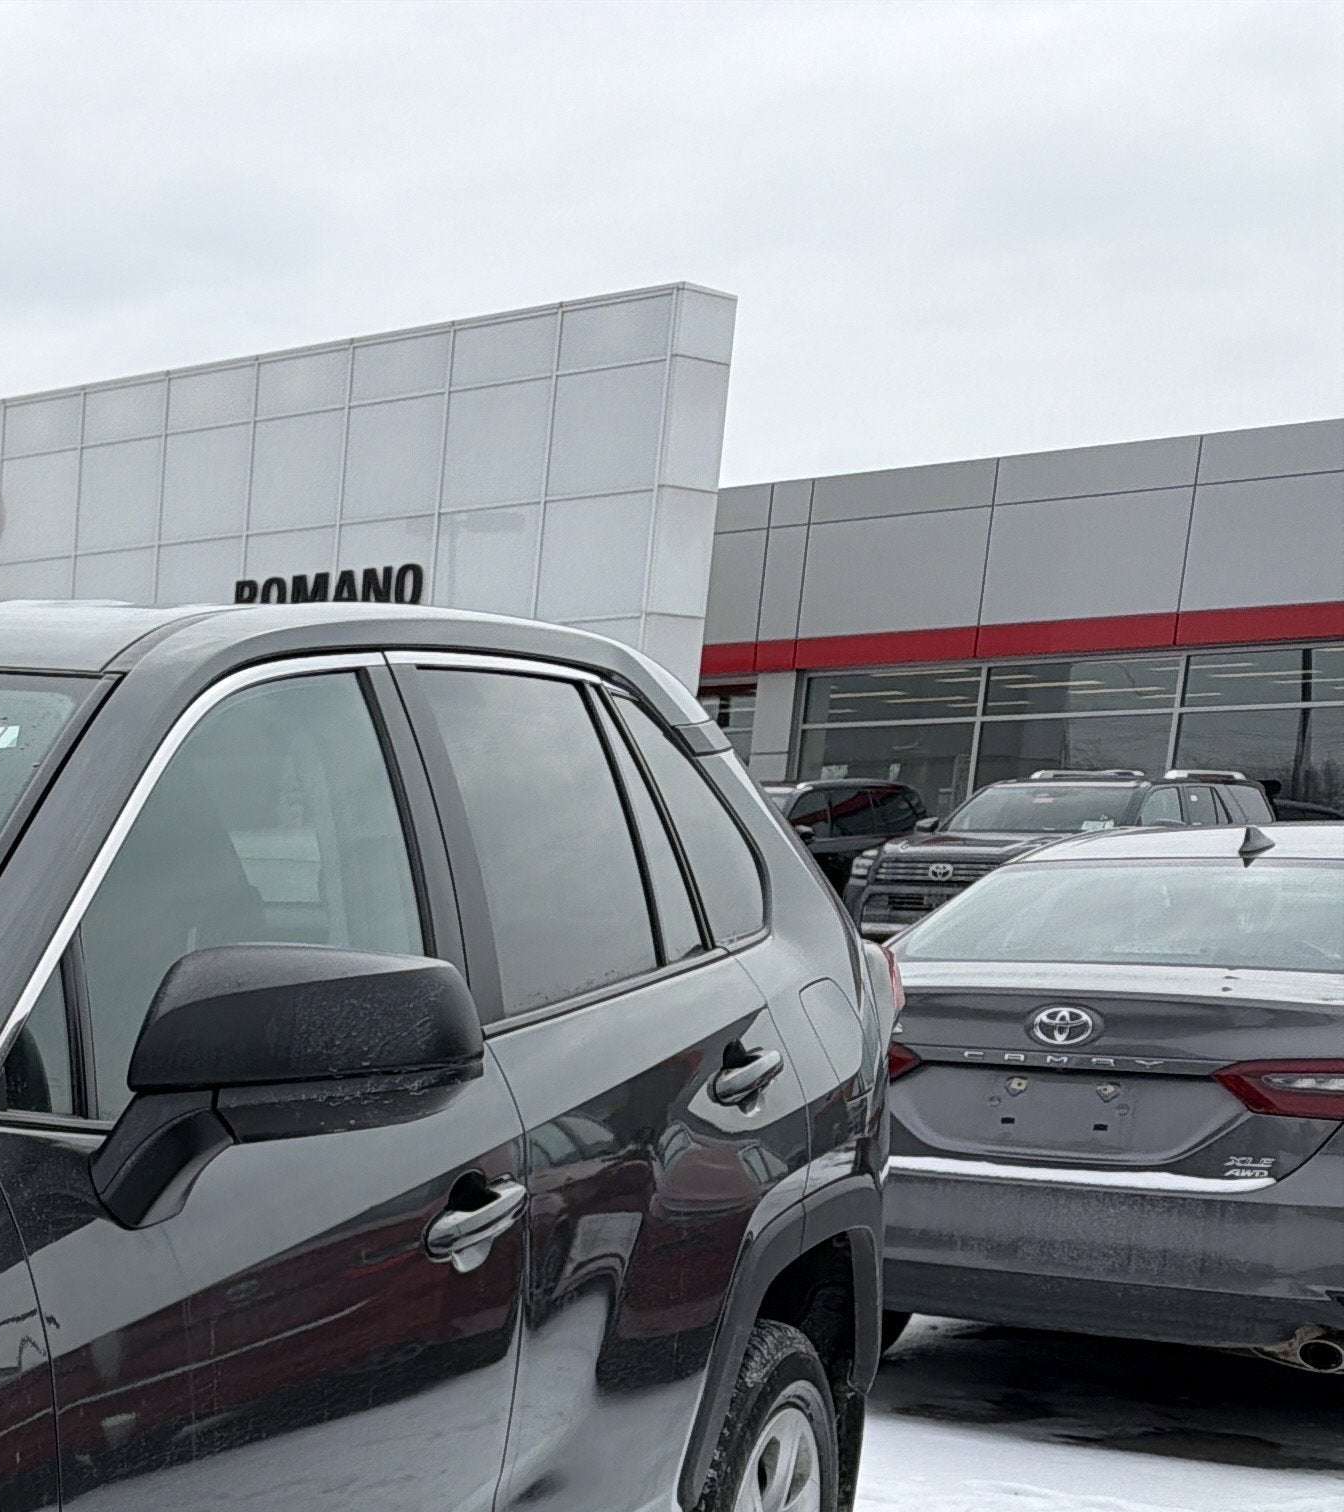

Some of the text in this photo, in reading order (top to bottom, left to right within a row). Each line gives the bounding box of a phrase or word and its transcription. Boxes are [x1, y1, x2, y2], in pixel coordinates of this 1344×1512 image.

[234, 563, 423, 605] ROMANO
[963, 1050, 1164, 1069] CAMRY
[1223, 1156, 1276, 1168] XLE
[1223, 1168, 1269, 1177] AWD
